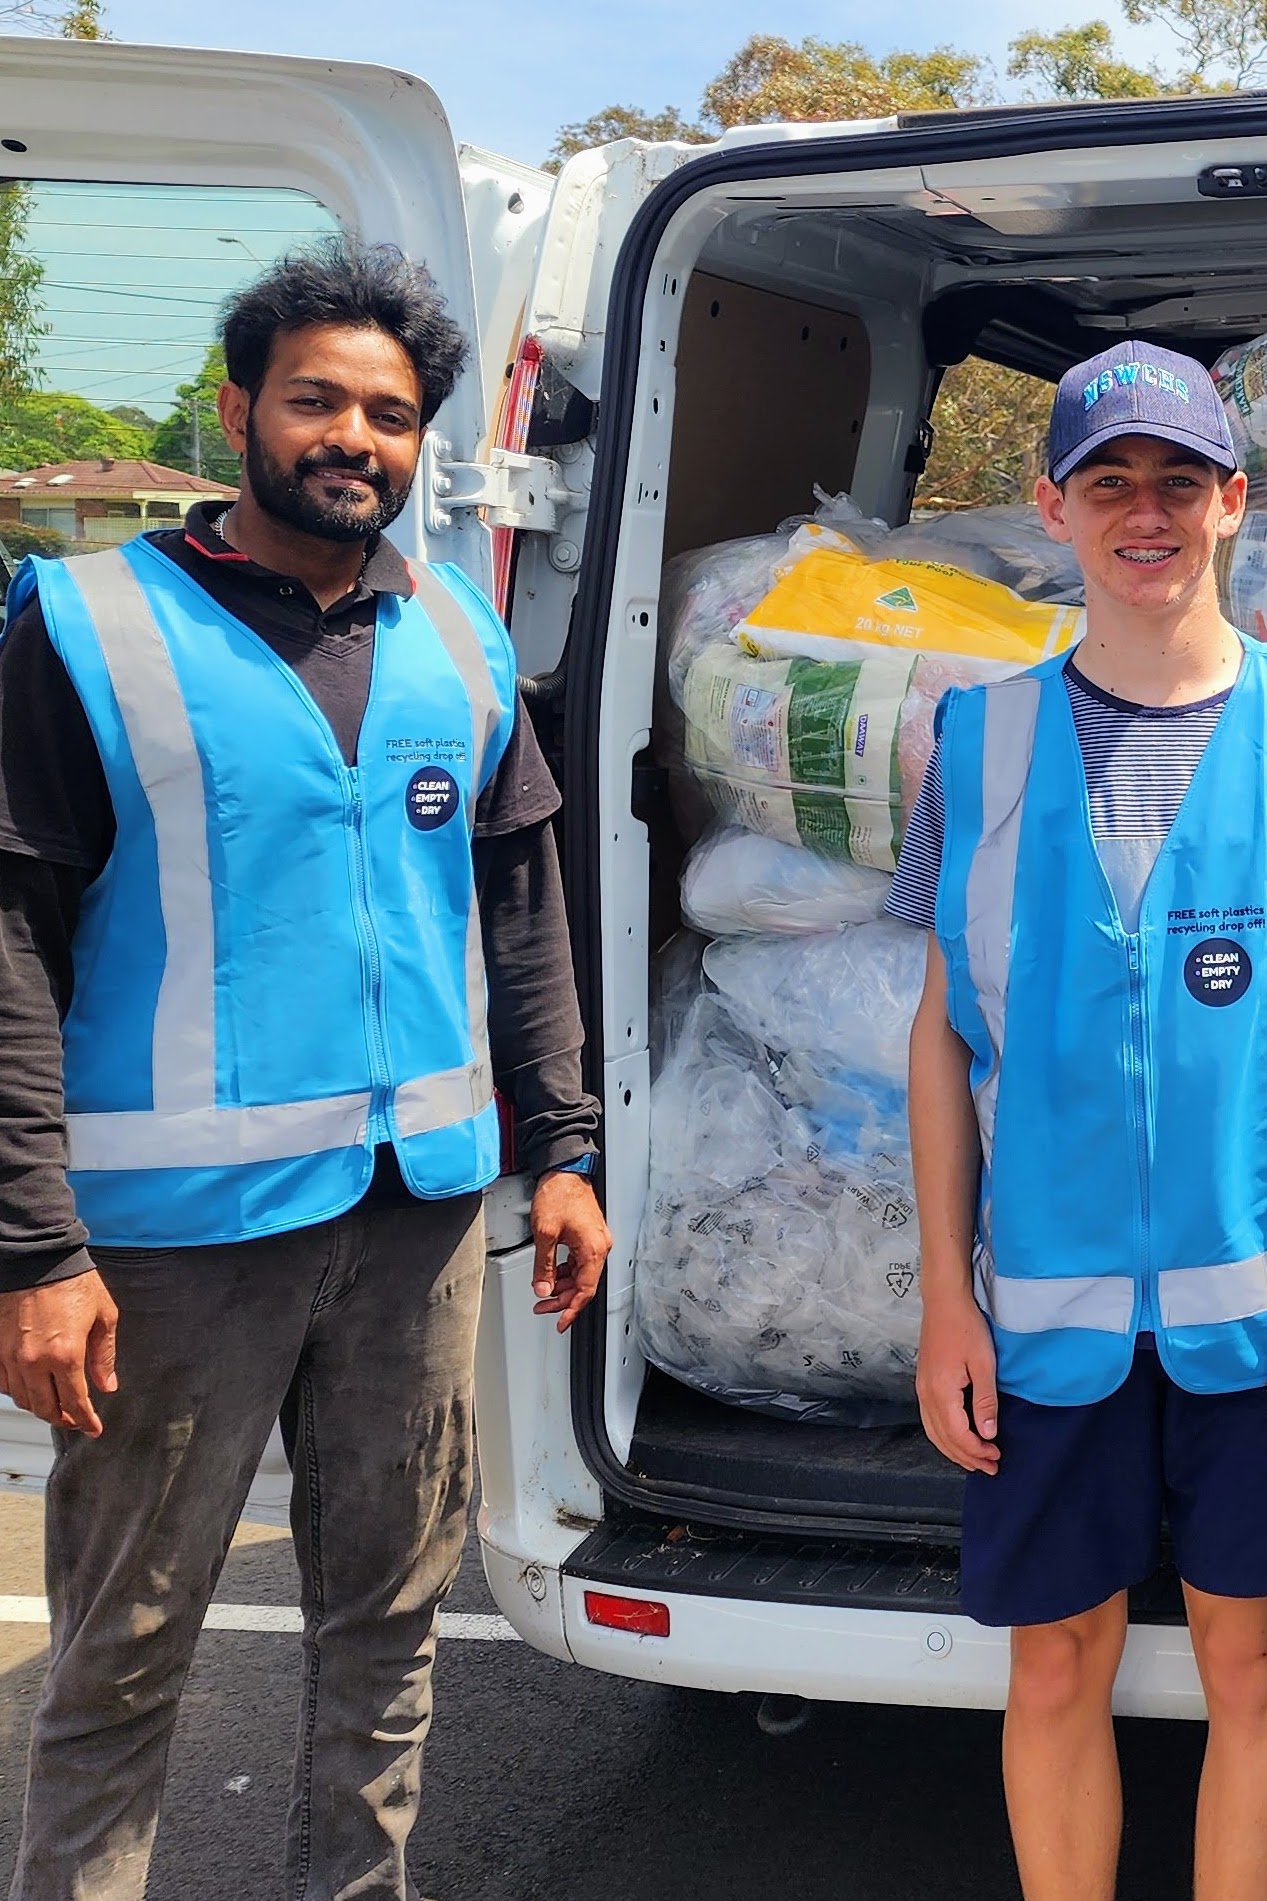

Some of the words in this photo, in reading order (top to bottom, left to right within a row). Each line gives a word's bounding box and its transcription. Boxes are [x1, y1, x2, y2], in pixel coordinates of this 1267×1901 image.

[855, 616, 872, 632] 20
[874, 620, 891, 638] kg
[893, 623, 924, 639] NET
[385, 738, 412, 749] FREE
[414, 738, 434, 748] soft
[436, 738, 466, 749] plastics
[386, 751, 431, 763] recycling
[433, 750, 454, 762] drop
[417, 780, 450, 791] CLEAN
[415, 793, 450, 803] EMPTY
[421, 805, 442, 815] DRY
[1167, 909, 1196, 921] FREE
[1198, 908, 1220, 919] soft
[1222, 905, 1265, 920] plastics
[1167, 922, 1216, 936] recycling
[1218, 921, 1245, 933] drop
[1247, 918, 1267, 930] off!
[1202, 953, 1239, 964] CLEAN
[1201, 966, 1241, 978] EMPTY
[1210, 979, 1233, 990] DRY
